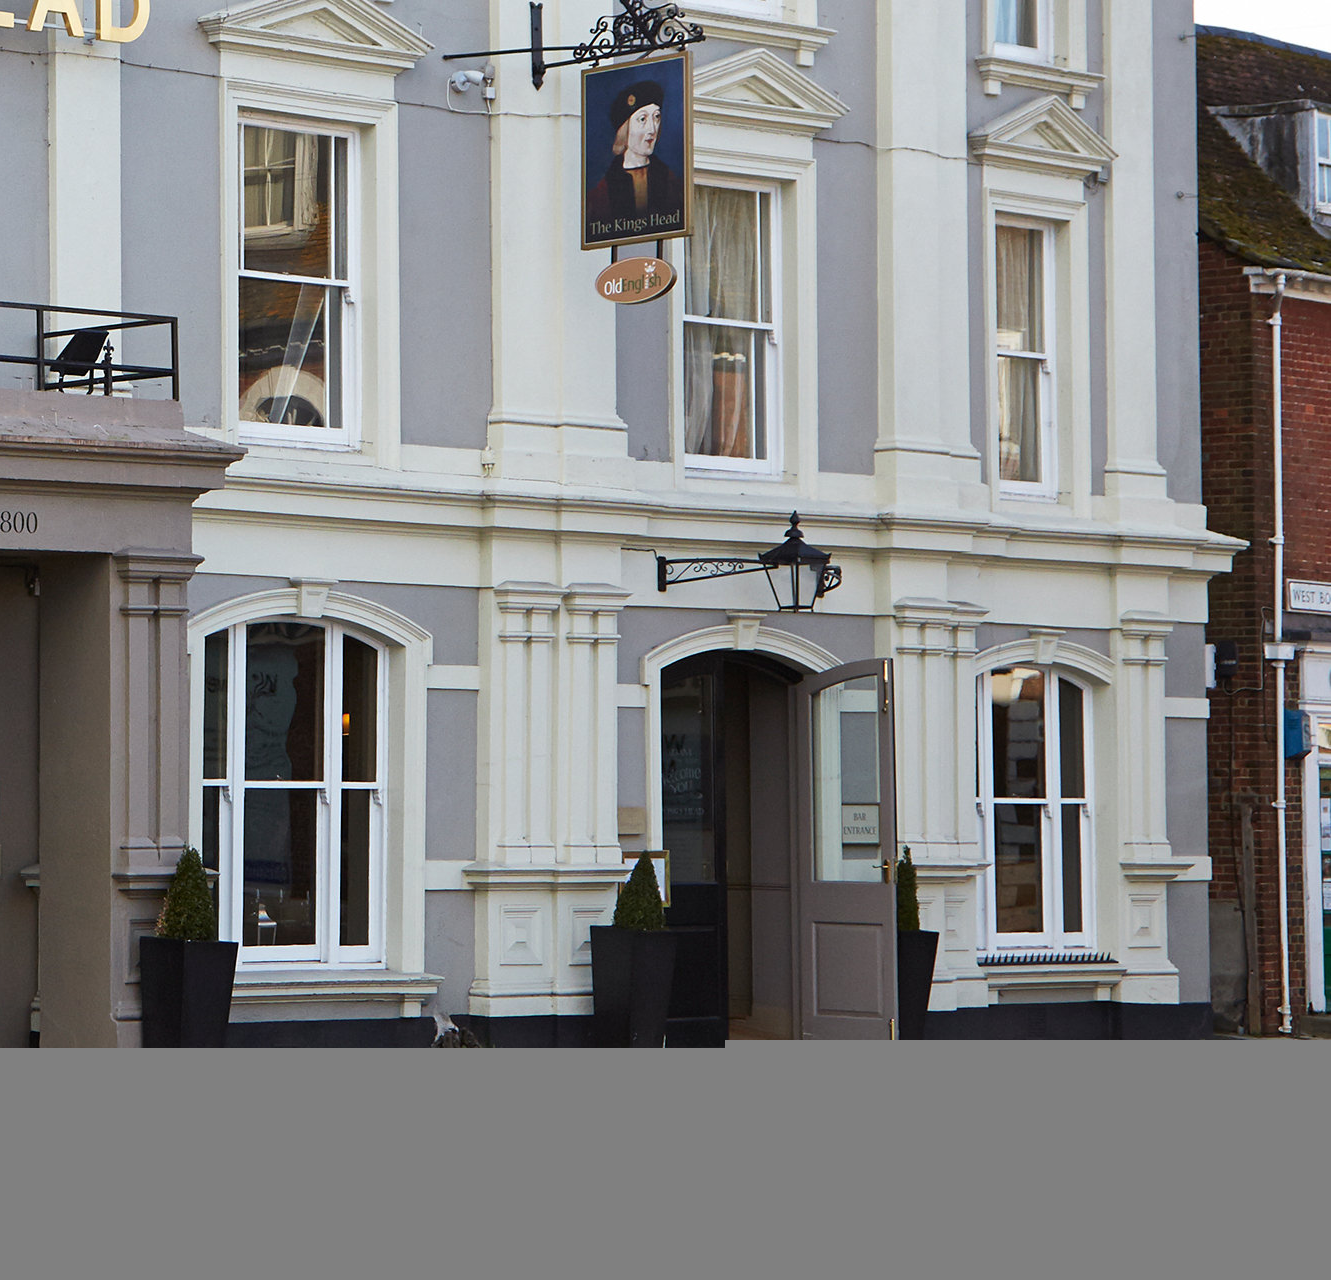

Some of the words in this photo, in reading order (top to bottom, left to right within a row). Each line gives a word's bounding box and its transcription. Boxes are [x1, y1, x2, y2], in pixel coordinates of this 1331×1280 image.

[589, 221, 612, 235] The
[614, 218, 648, 232] Kings
[650, 209, 680, 227] Head
[1292, 589, 1316, 603] WEST
[1319, 591, 1331, 605] BO
[853, 812, 866, 821] BAR
[843, 826, 877, 835] ENTRANCE
